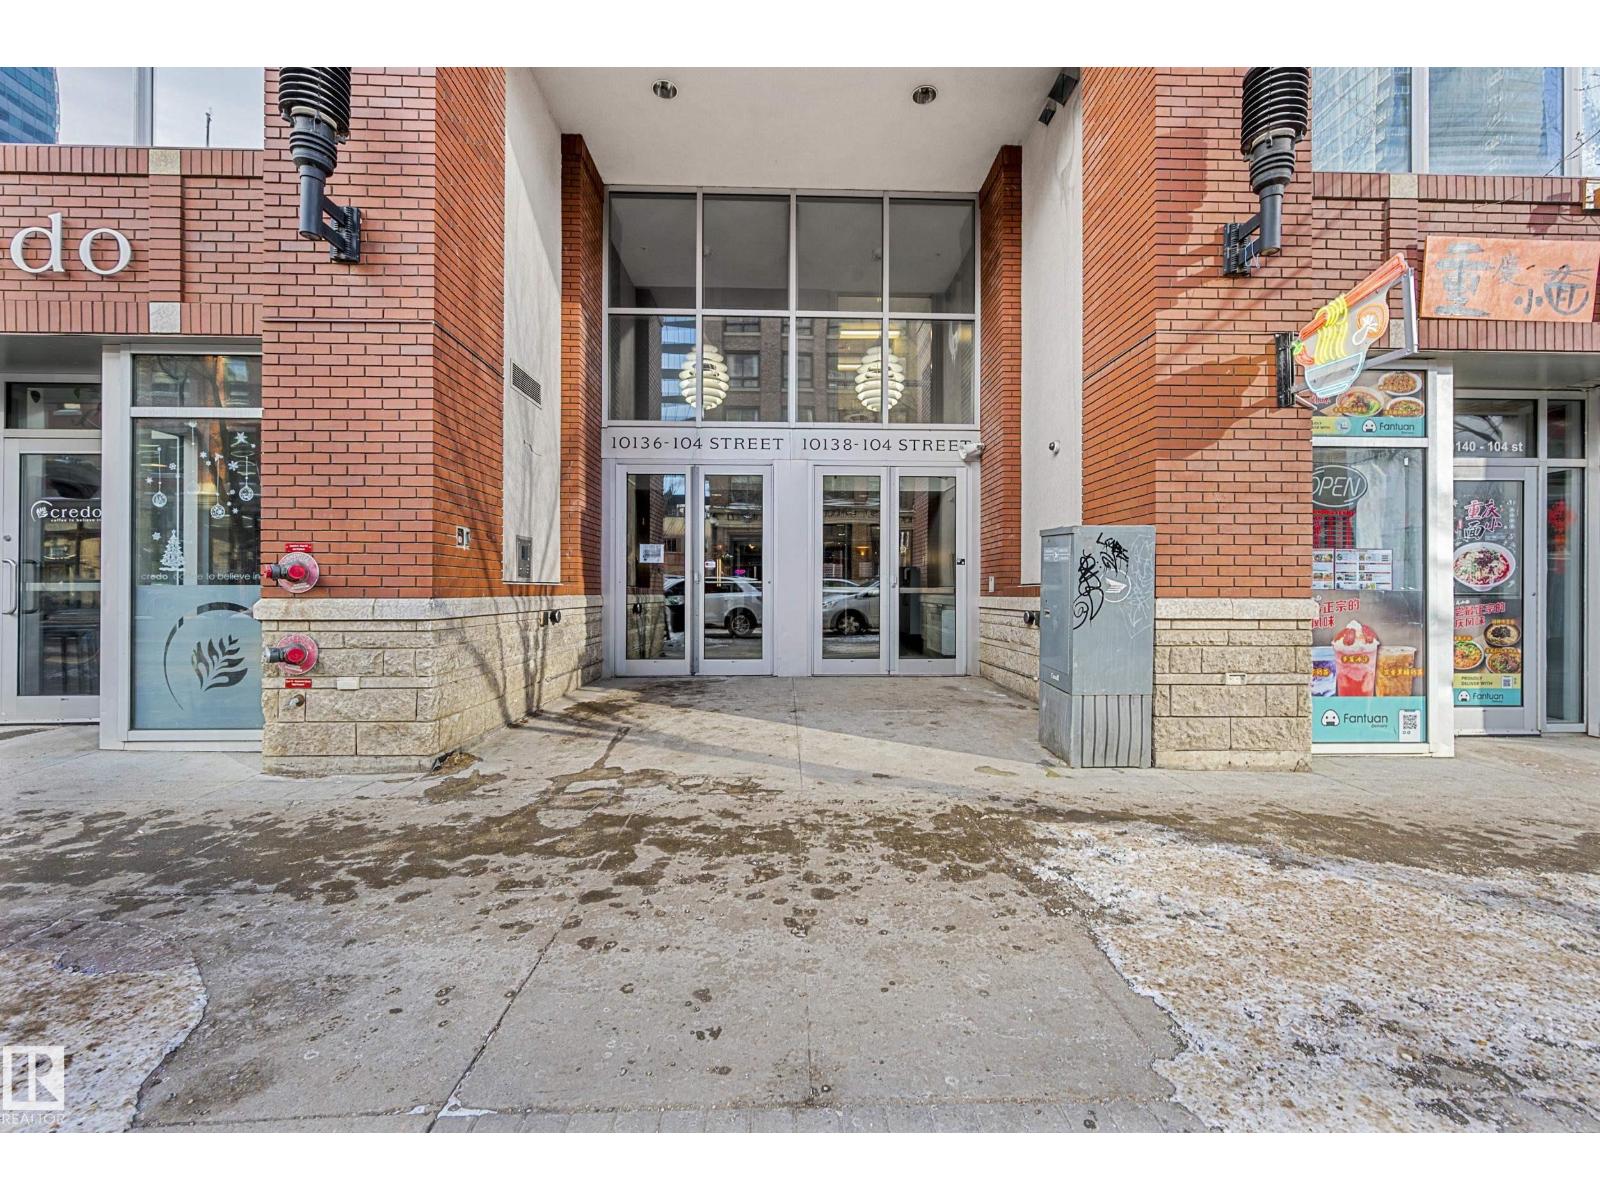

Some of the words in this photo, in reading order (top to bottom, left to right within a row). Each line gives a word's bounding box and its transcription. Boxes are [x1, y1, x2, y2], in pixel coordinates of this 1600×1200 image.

[1379, 422, 1415, 431] Fantuan
[610, 436, 703, 450] 10136-104
[709, 437, 784, 450] STREET
[802, 438, 892, 451] 10138-104
[1488, 440, 1508, 452] 104
[1511, 441, 1524, 452] st
[50, 506, 102, 518] credo
[141, 572, 169, 580] credo
[217, 572, 250, 580] believe
[1319, 599, 1360, 614] 正宗的
[1472, 692, 1504, 700] Fantuan
[1343, 713, 1389, 724] Fantuan
